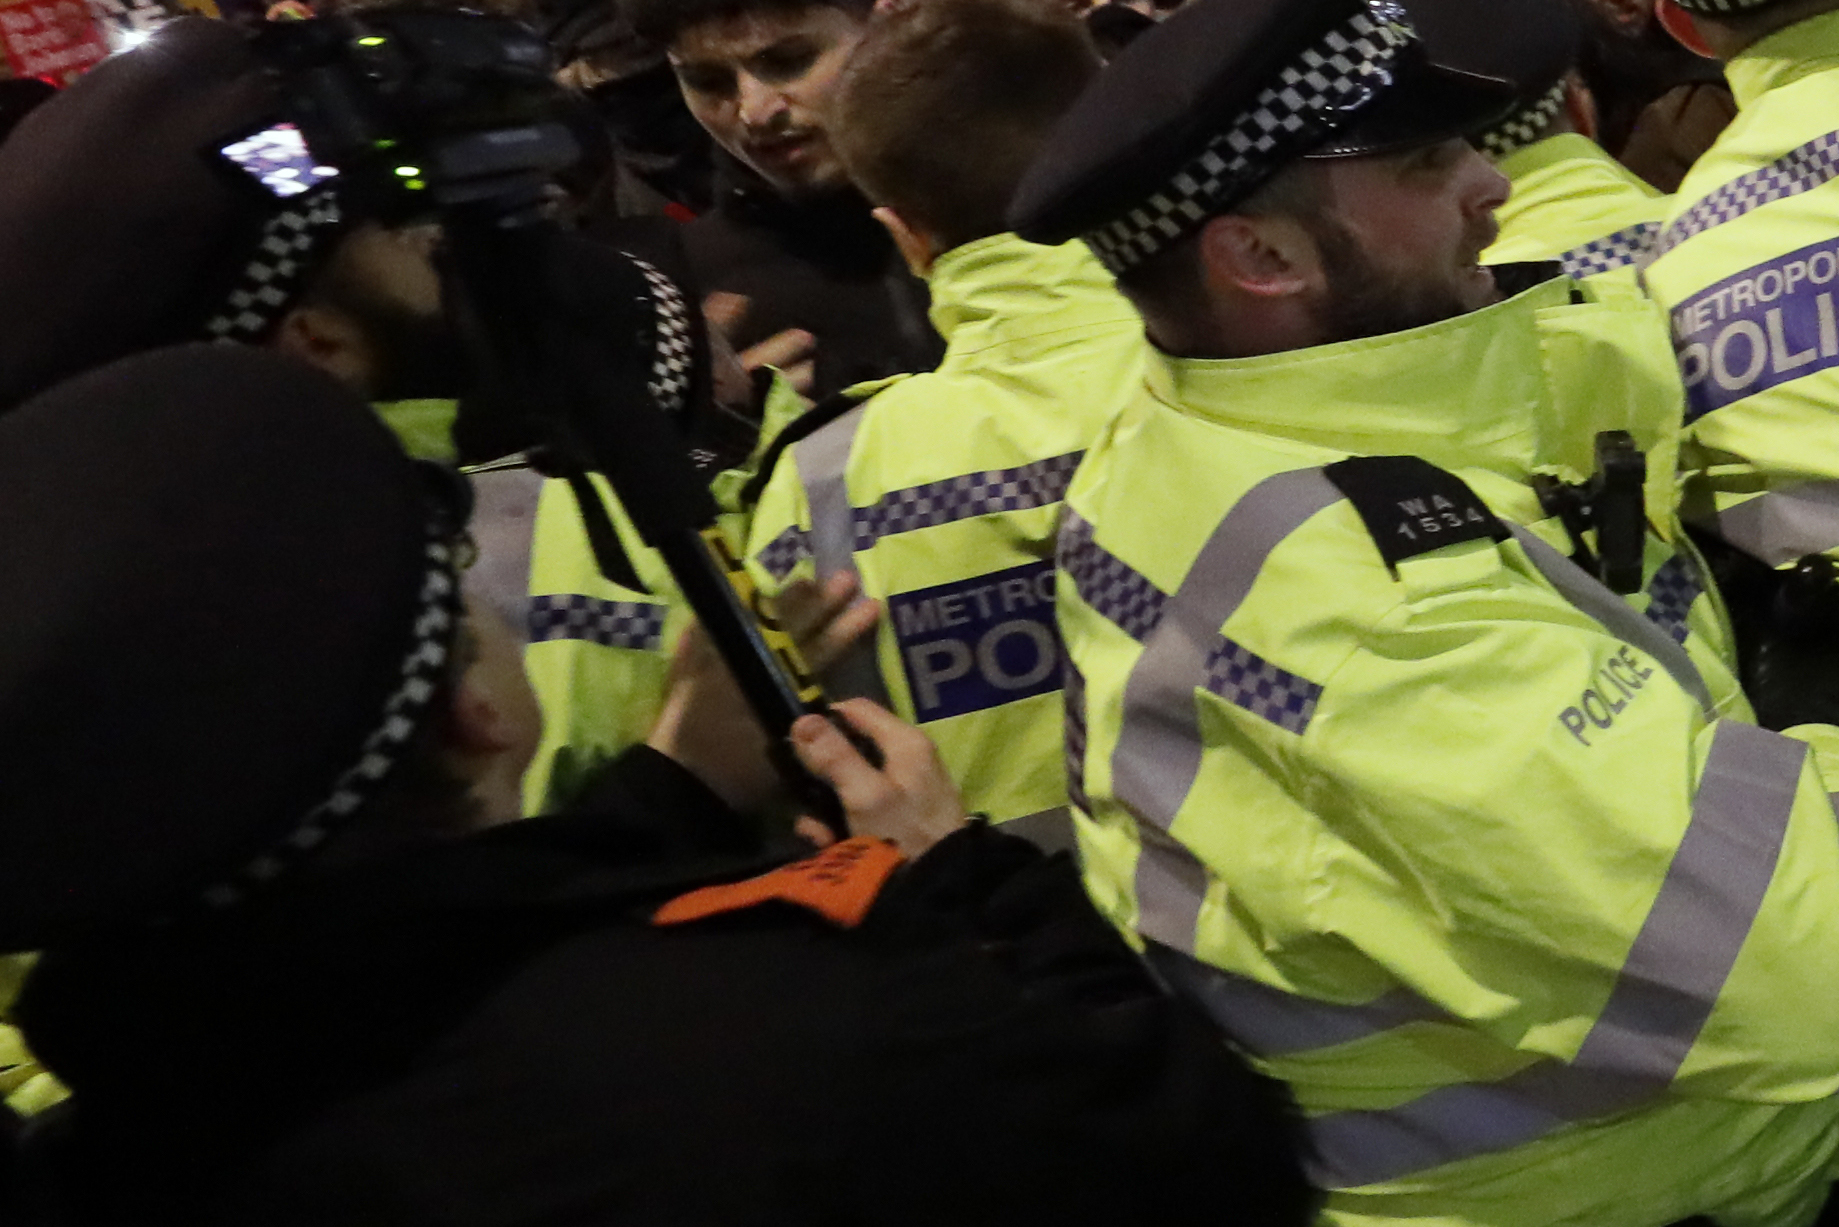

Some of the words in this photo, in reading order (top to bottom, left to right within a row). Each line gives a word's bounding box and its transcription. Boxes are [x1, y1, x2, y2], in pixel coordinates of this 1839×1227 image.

[1397, 506, 1485, 541] 1534
[1398, 493, 1455, 518] WA
[897, 569, 1057, 637] METRO
[906, 618, 1057, 711] PO
[1557, 644, 1655, 747] POLICE
